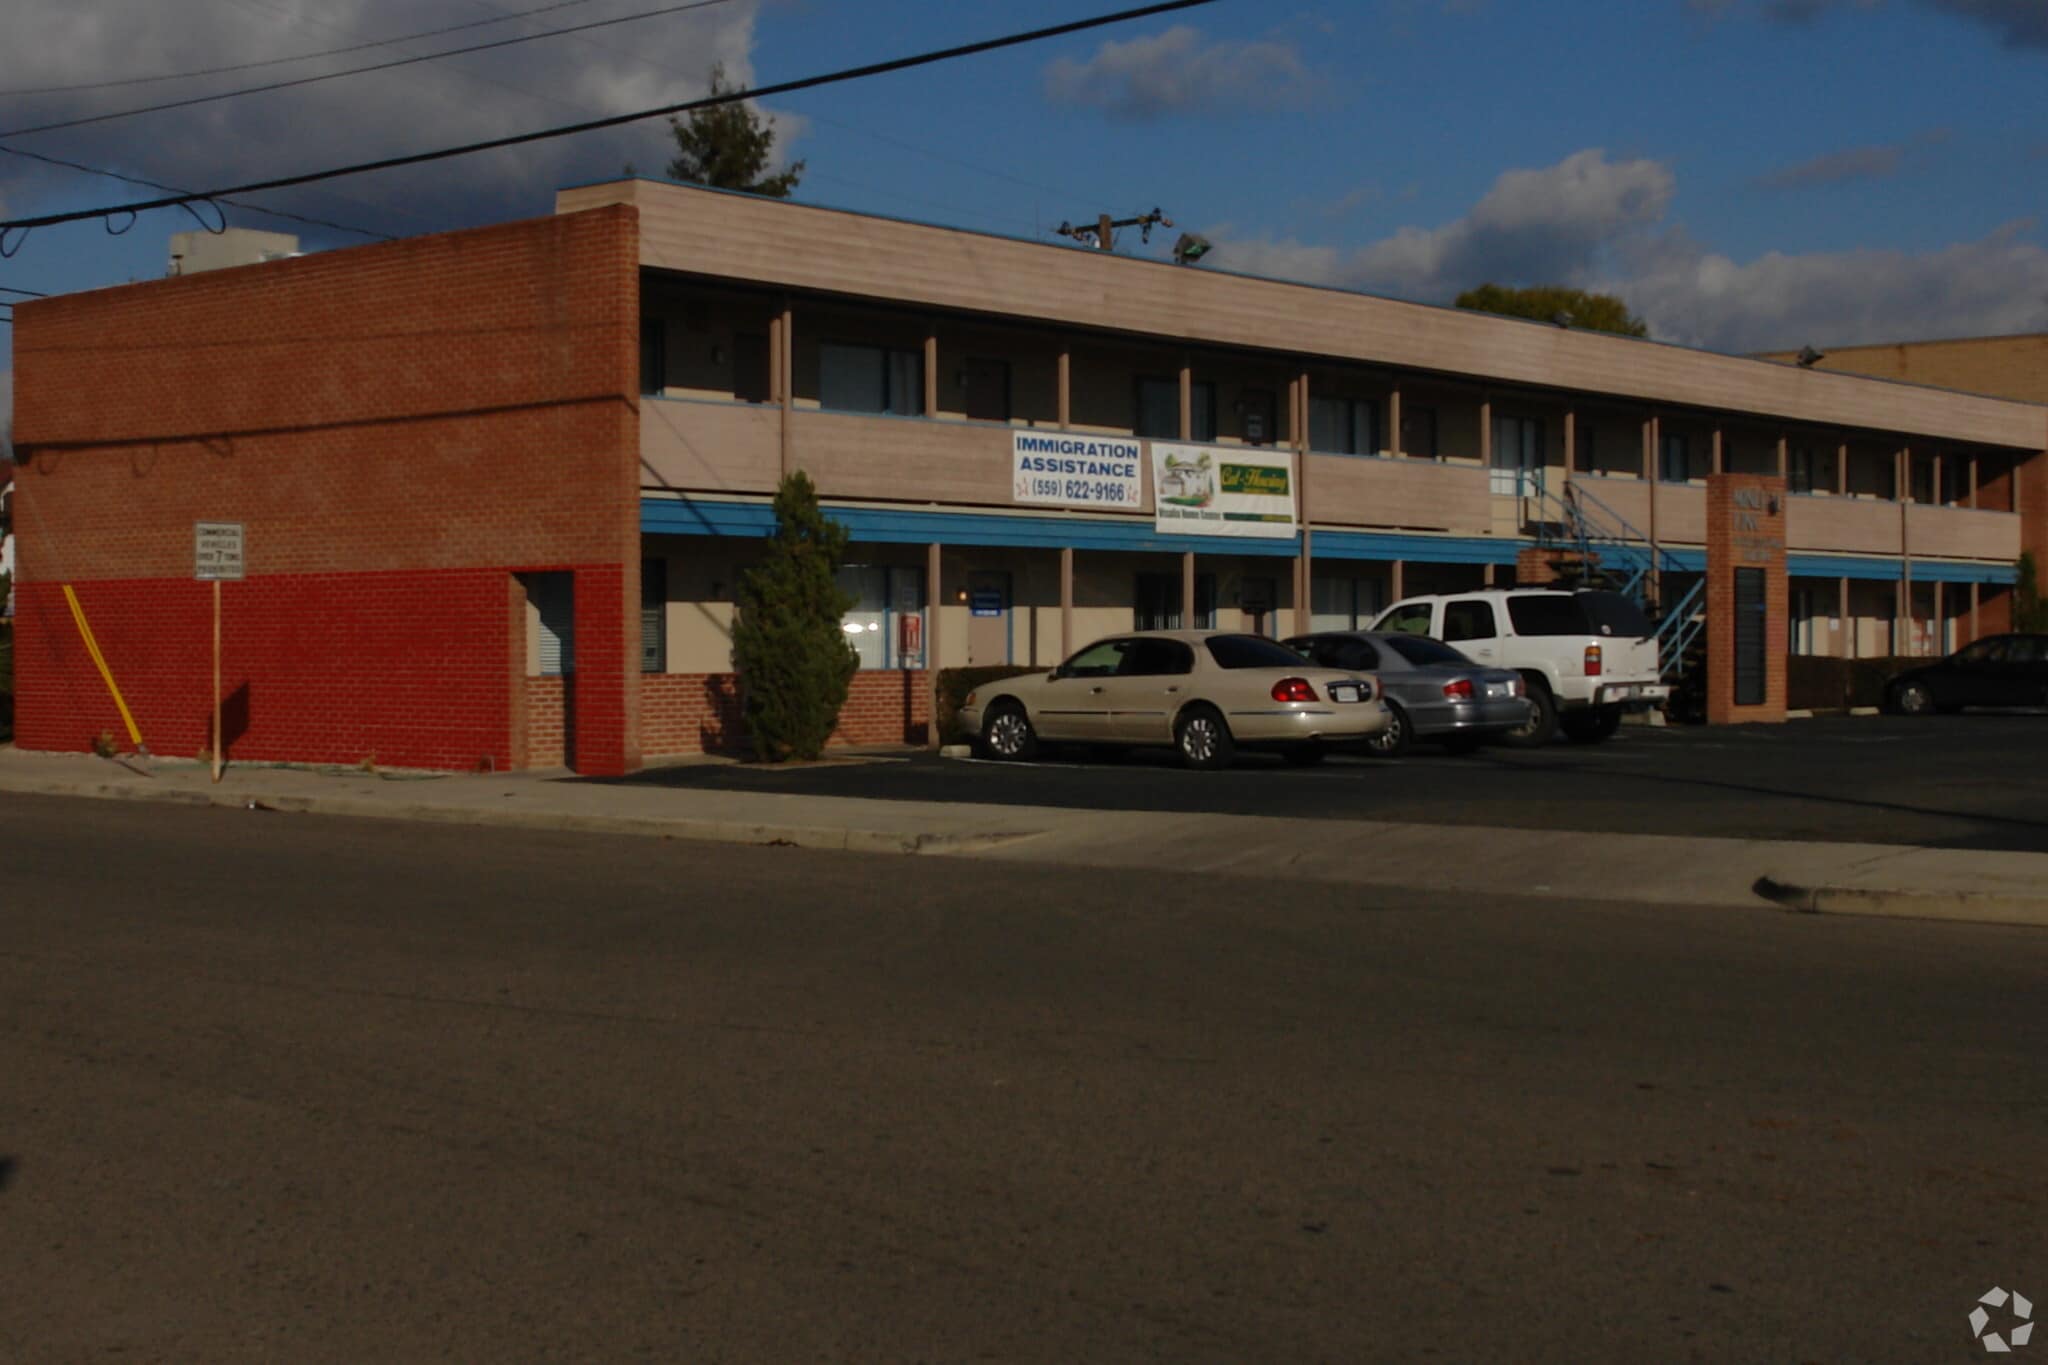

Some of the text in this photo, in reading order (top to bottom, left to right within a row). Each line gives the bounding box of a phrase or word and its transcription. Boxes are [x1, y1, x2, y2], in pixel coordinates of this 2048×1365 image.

[1016, 437, 1138, 459] IMMIGRATION
[1020, 456, 1136, 477] ASSISTANCE
[1032, 478, 1125, 501] (559) 622-9166
